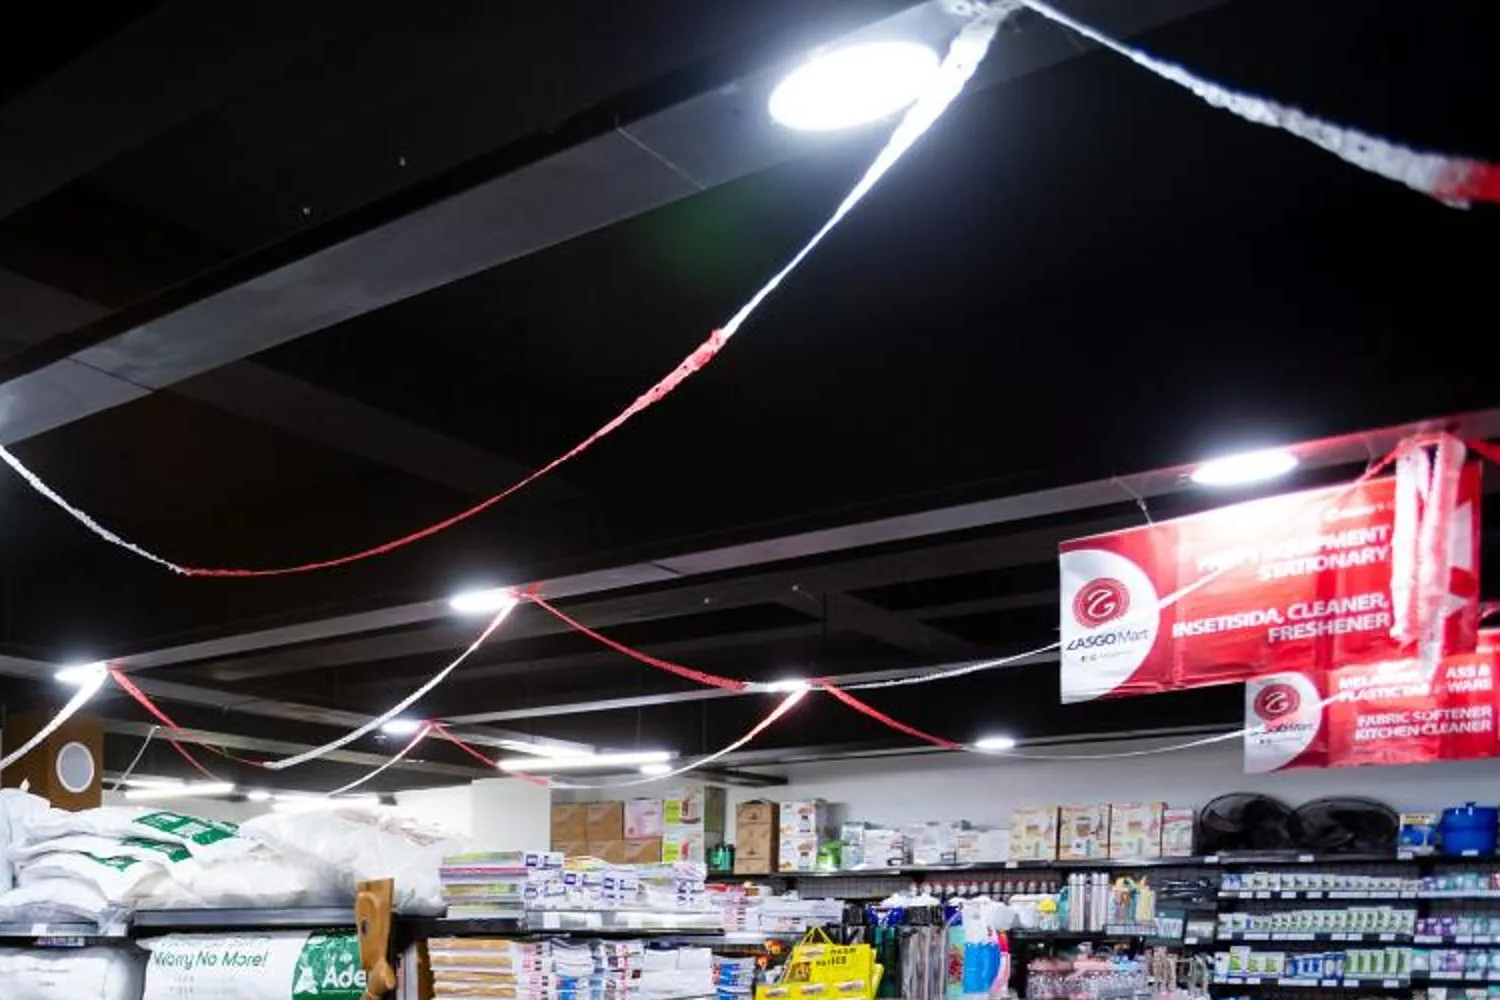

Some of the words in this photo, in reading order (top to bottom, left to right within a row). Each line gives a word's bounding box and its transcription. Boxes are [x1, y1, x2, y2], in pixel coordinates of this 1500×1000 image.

[1267, 612, 1390, 643] FRESHENER
[1066, 633, 1117, 651] ZASGO
[1412, 705, 1493, 722] SOFTENER
[1421, 719, 1493, 736] CLEANER
[152, 951, 192, 970] Worry
[195, 951, 217, 966] No
[221, 951, 269, 967] More!
